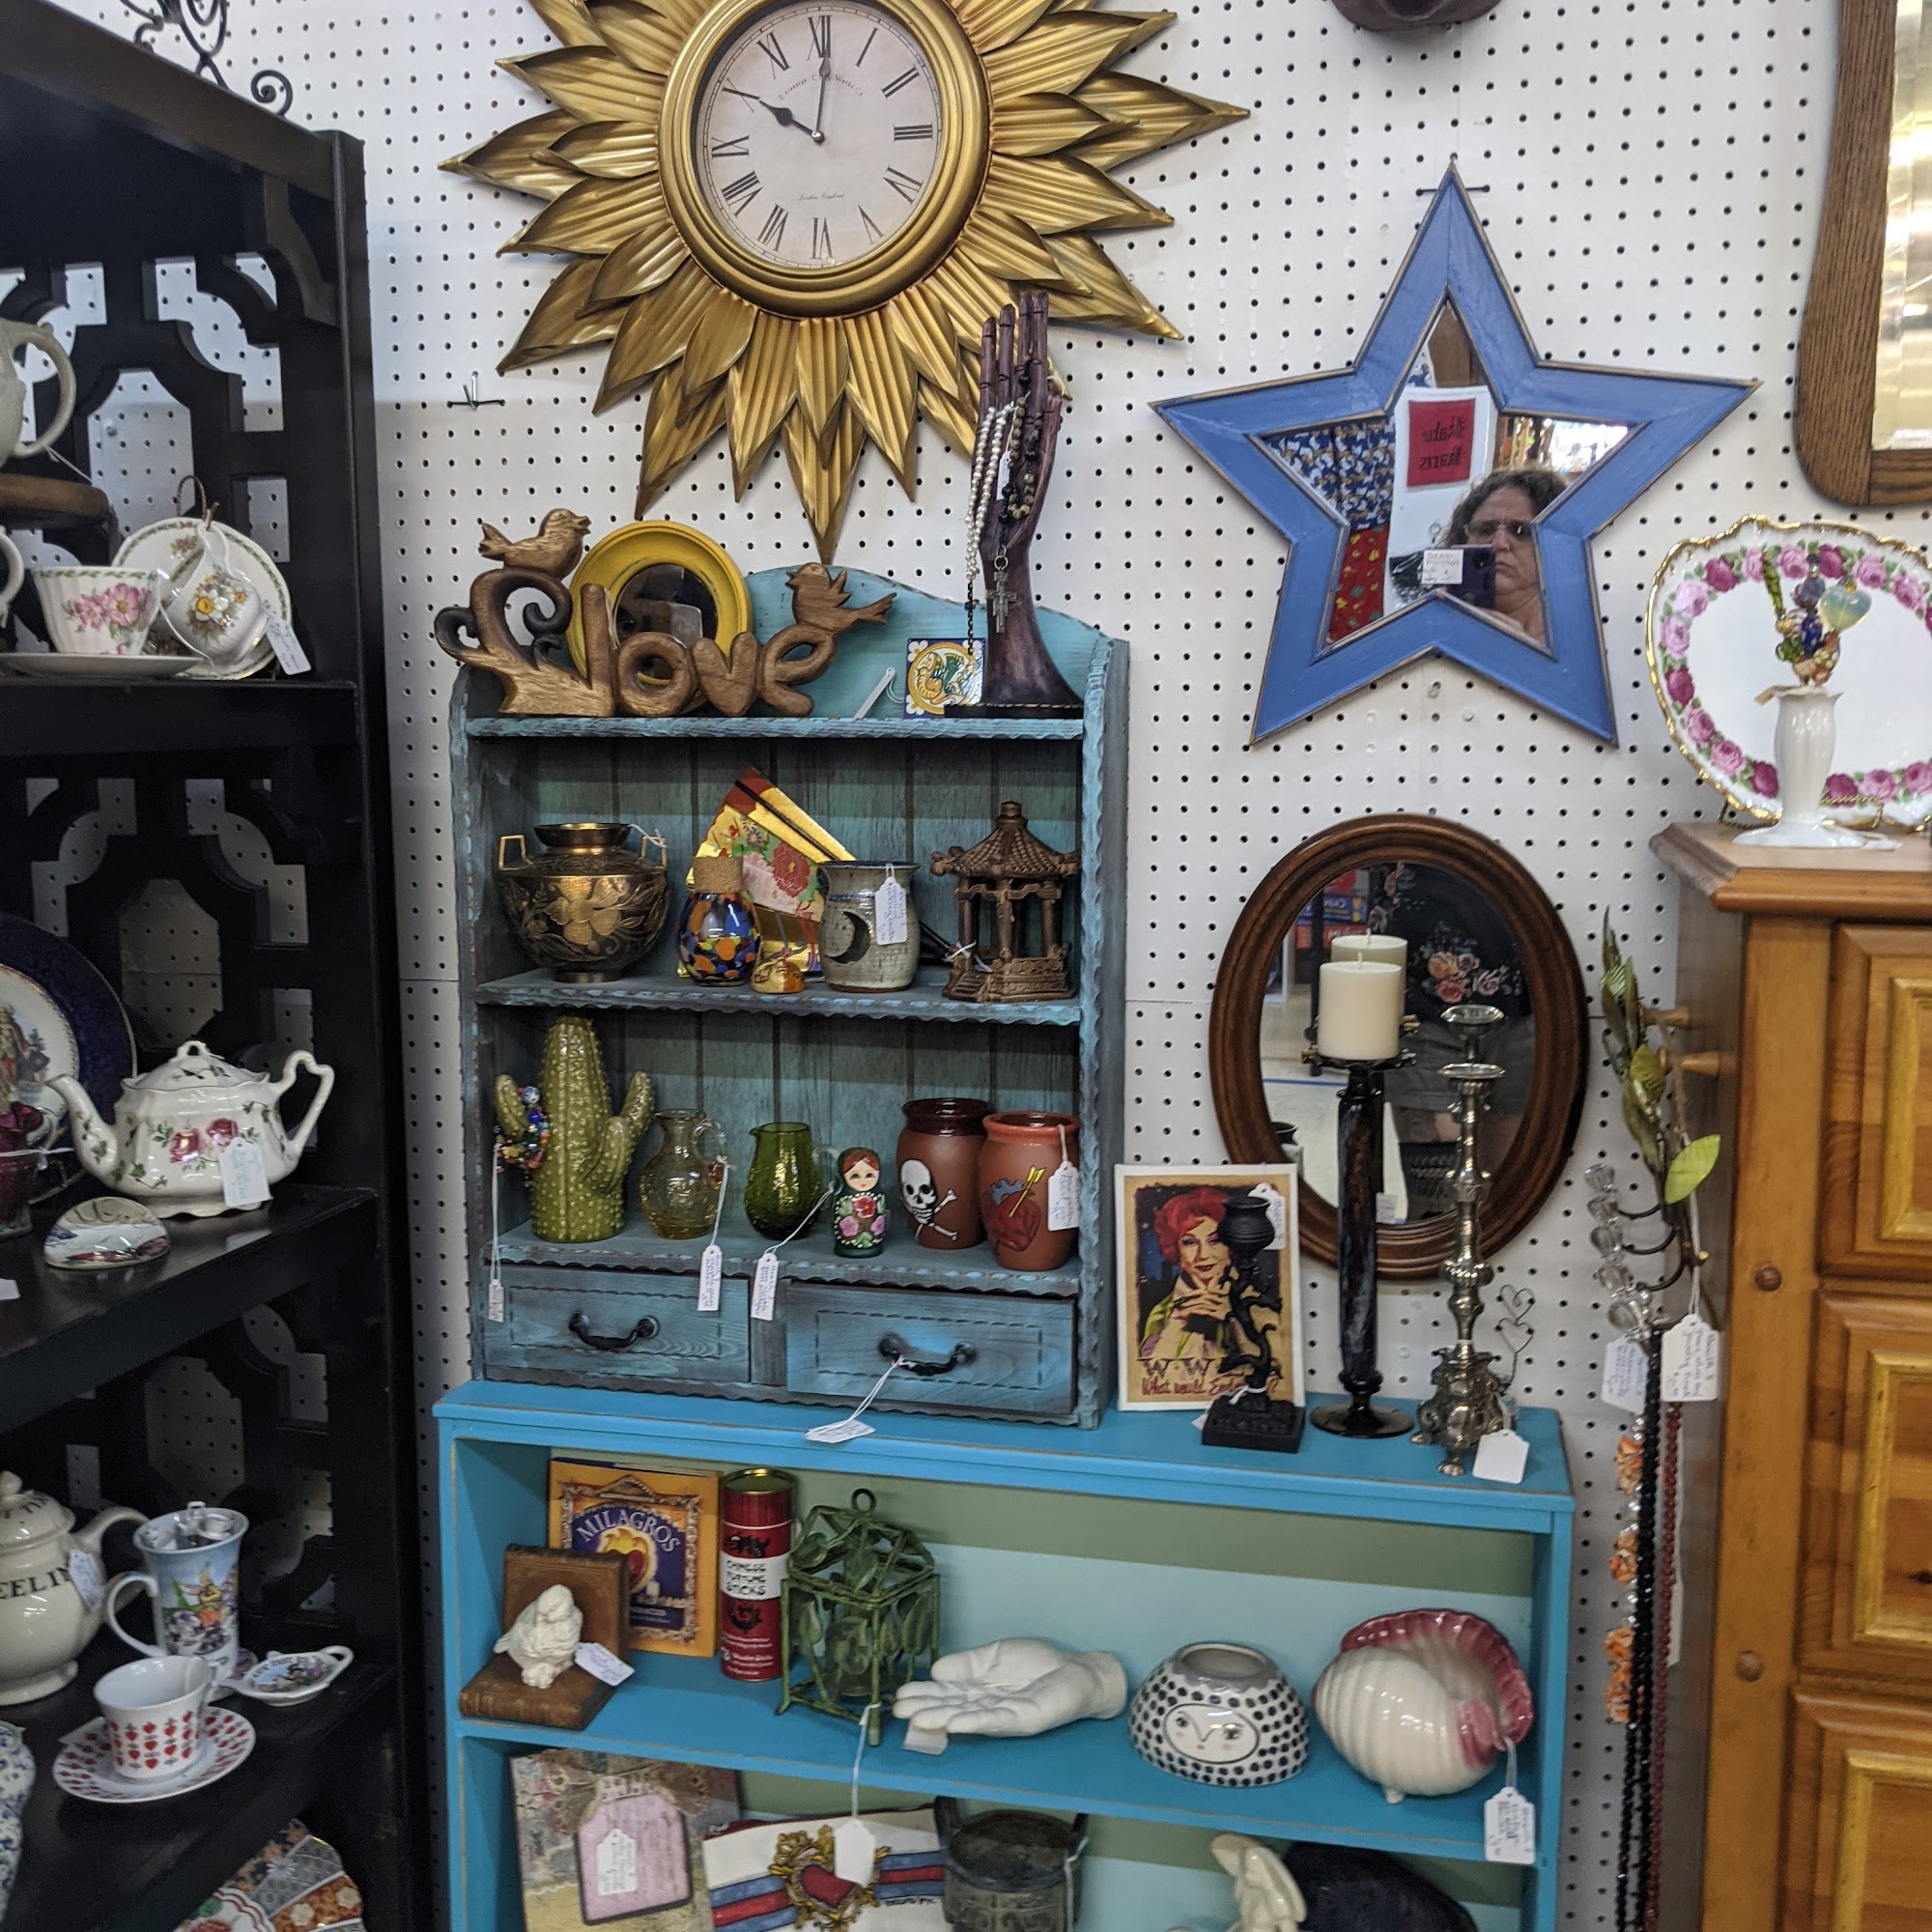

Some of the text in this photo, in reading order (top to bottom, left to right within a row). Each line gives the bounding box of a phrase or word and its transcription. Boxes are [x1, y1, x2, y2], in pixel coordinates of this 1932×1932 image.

[756, 32, 790, 80] XI
[807, 14, 832, 61] XII
[855, 27, 879, 68] I
[722, 77, 761, 113] X
[881, 64, 920, 99] II
[711, 135, 750, 160] IX
[894, 124, 933, 142] III
[722, 171, 763, 217] VIII
[757, 204, 789, 253] VII
[811, 217, 834, 260] VI
[858, 205, 885, 244] V
[577, 1509, 681, 1553] MILAGROS
[726, 1581, 766, 1595] STICKS
